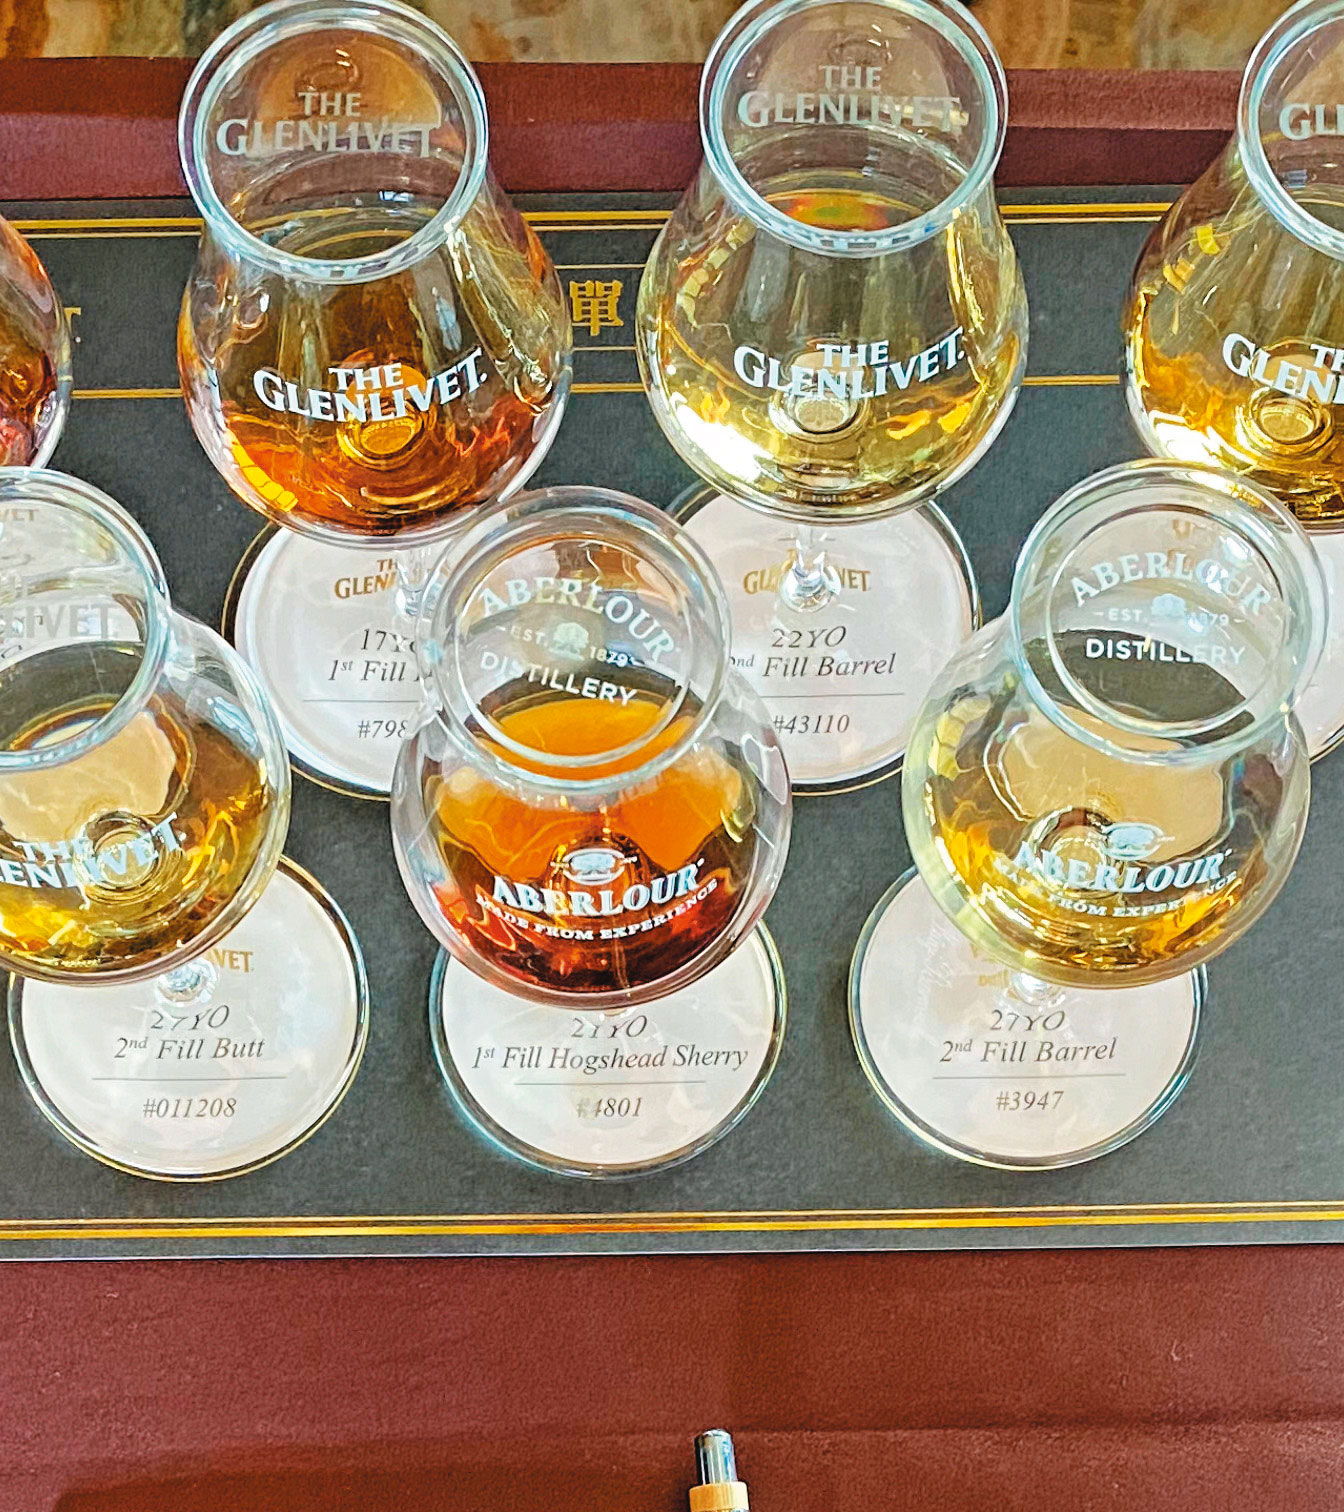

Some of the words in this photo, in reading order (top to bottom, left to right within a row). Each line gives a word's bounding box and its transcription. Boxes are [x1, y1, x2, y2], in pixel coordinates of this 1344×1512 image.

[818, 65, 883, 92] THE
[298, 91, 362, 117] THE
[816, 340, 890, 368] THE
[328, 361, 405, 392] THE
[479, 576, 676, 667] ABERLOUR
[771, 625, 848, 649] 22YO
[1085, 637, 1247, 665] DISTILLERY
[360, 659, 407, 683] Fill
[479, 650, 639, 707] DISTILLERY
[762, 655, 808, 678] Fill
[816, 652, 898, 678] Barrel
[772, 714, 851, 735] #43110
[1012, 841, 1226, 894] ABERLOUR
[492, 862, 702, 918] ABERLOUR
[533, 922, 595, 941] FROM
[599, 878, 719, 941] EXPERIENCE
[990, 1009, 1066, 1032] 27YO
[114, 1036, 149, 1060] 2nd
[156, 1038, 205, 1060] Fill
[211, 1037, 266, 1060] Butt
[471, 1046, 496, 1069] 1st
[501, 1046, 542, 1069] Fill
[548, 1045, 669, 1075] Hogshead
[672, 1044, 749, 1071] Sherry
[939, 1038, 974, 1063] 2nd
[980, 1040, 1027, 1063] Fill
[1034, 1036, 1119, 1063] Barrel
[142, 1097, 238, 1119] #011208
[995, 1090, 1065, 1111] #3947
